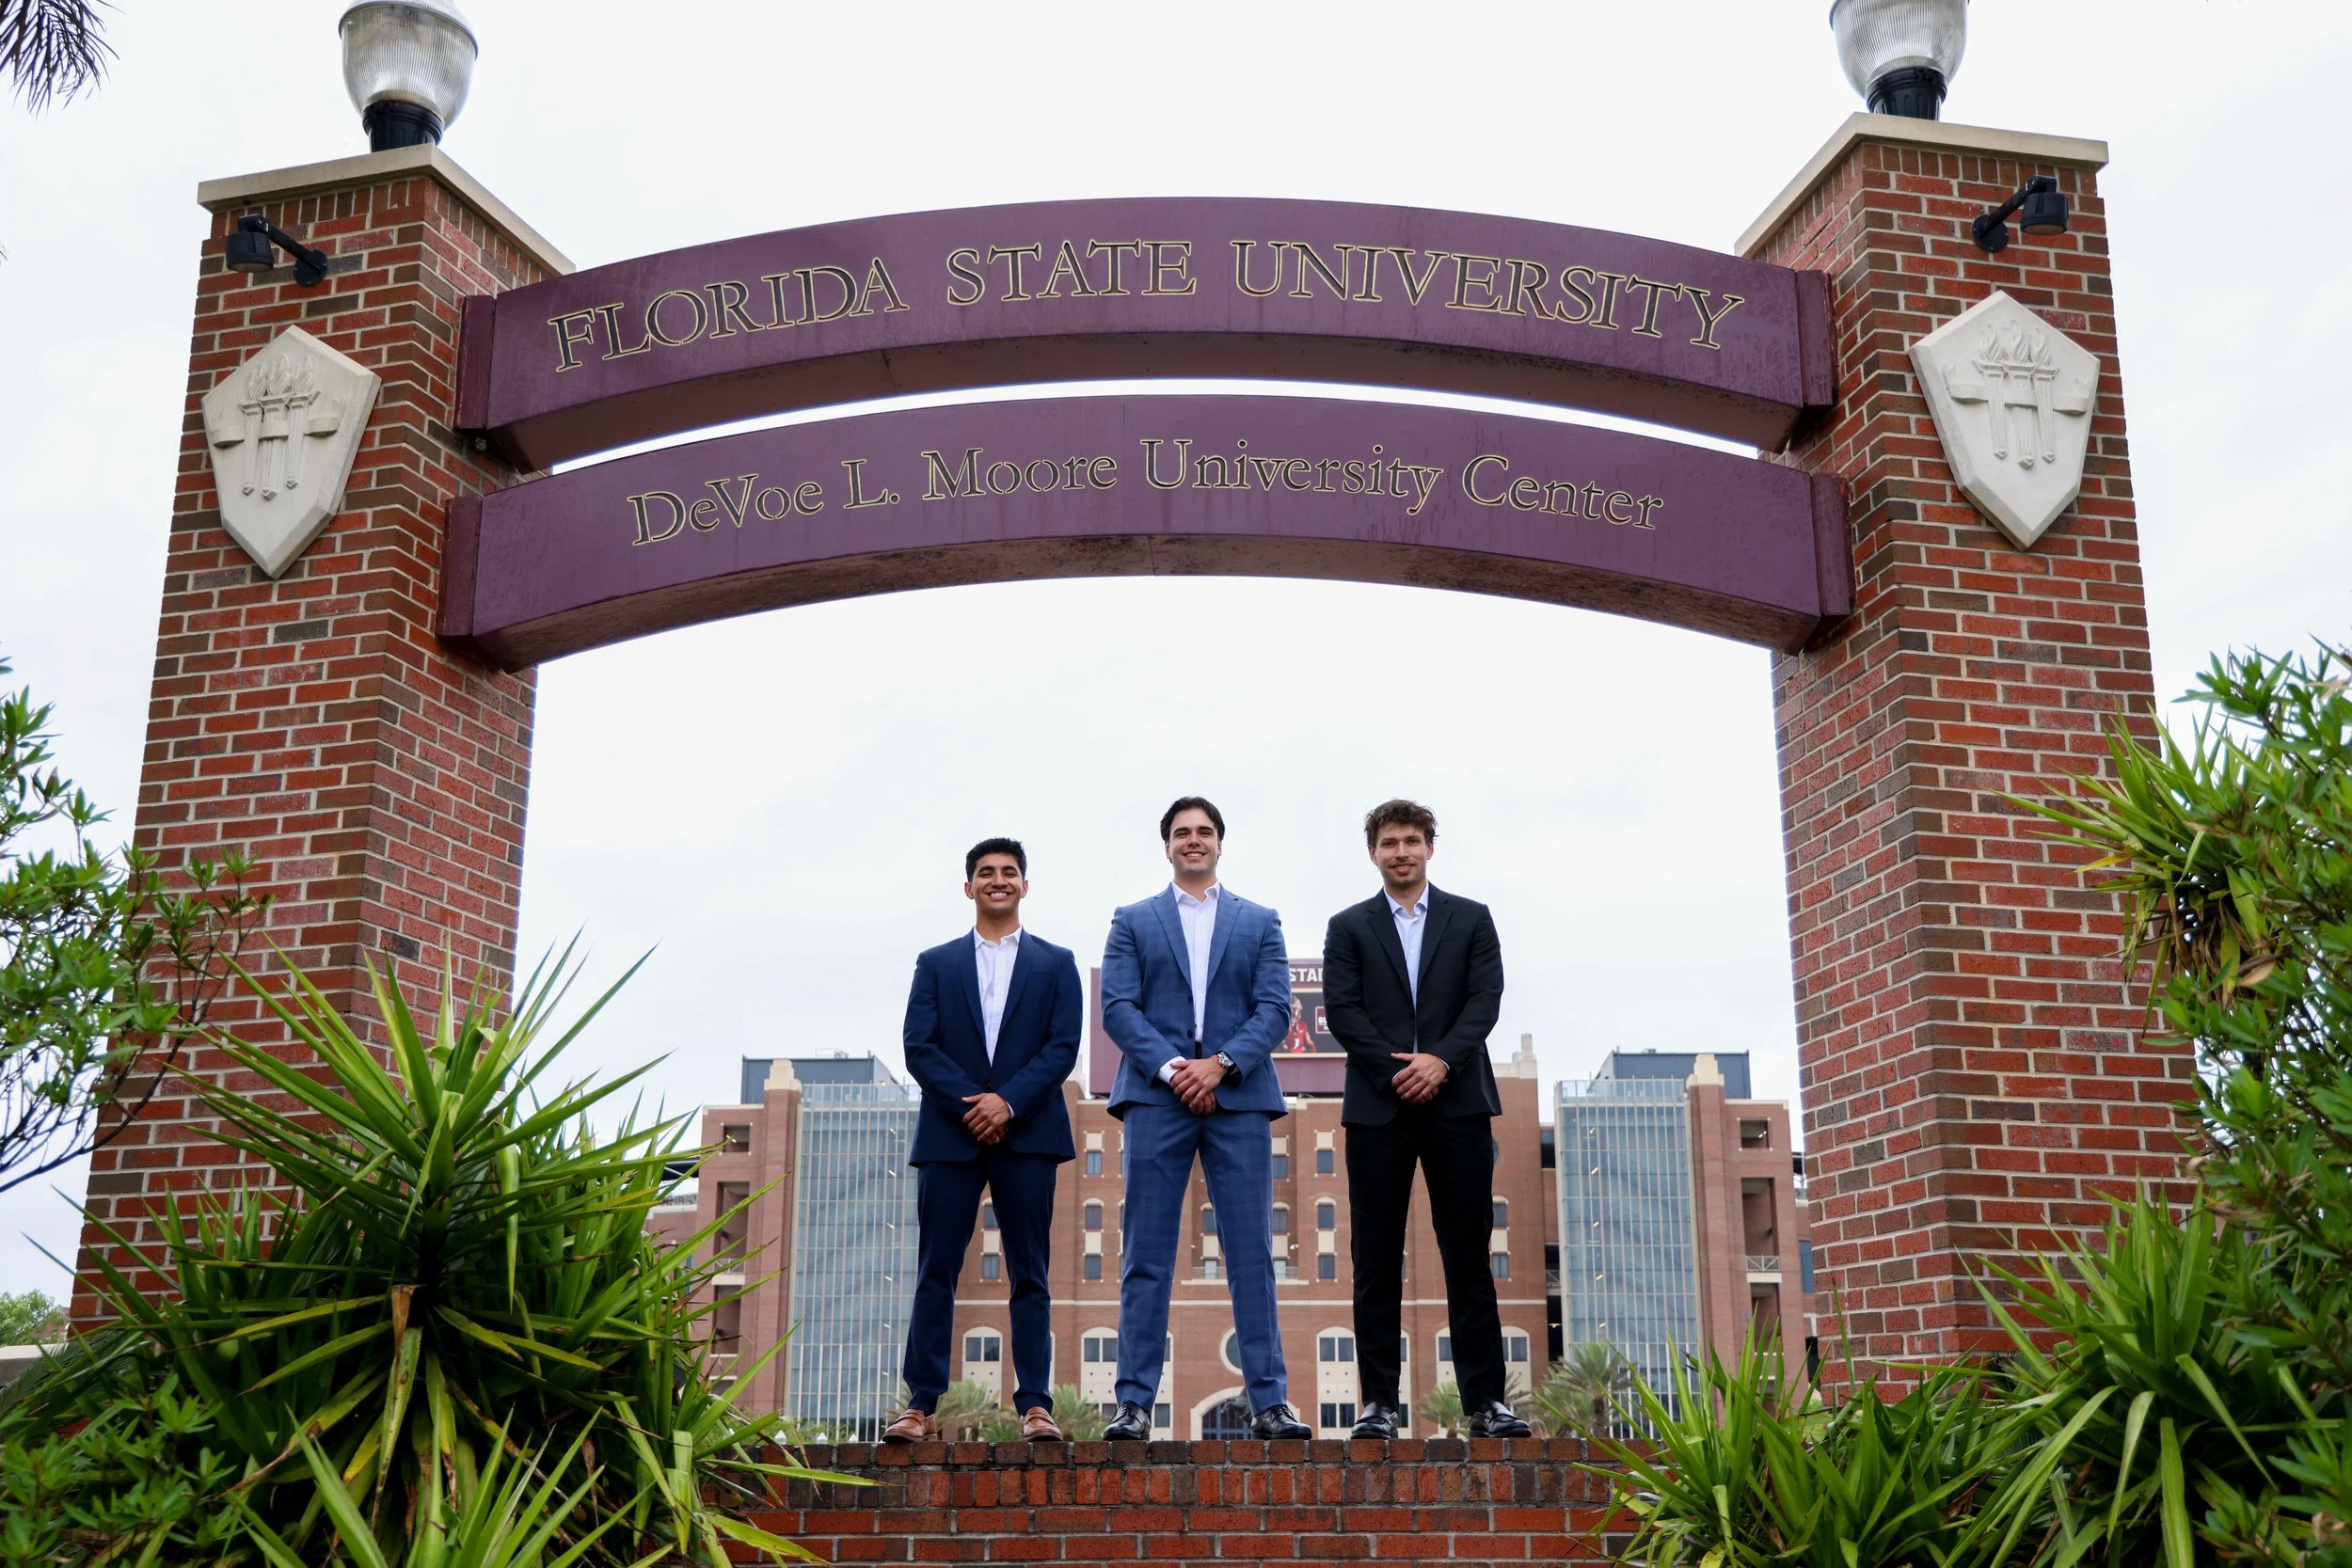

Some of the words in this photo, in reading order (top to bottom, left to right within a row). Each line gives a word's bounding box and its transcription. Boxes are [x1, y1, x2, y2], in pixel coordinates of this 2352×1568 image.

[547, 256, 909, 372] FLORIDA
[946, 238, 1197, 306] STATE
[1230, 239, 1744, 349] UNIVERSITY
[627, 472, 824, 546] DeVoe
[841, 458, 901, 510] L.
[920, 447, 1118, 500] Moore
[1139, 438, 1443, 515] University
[1461, 453, 1664, 531] Center
